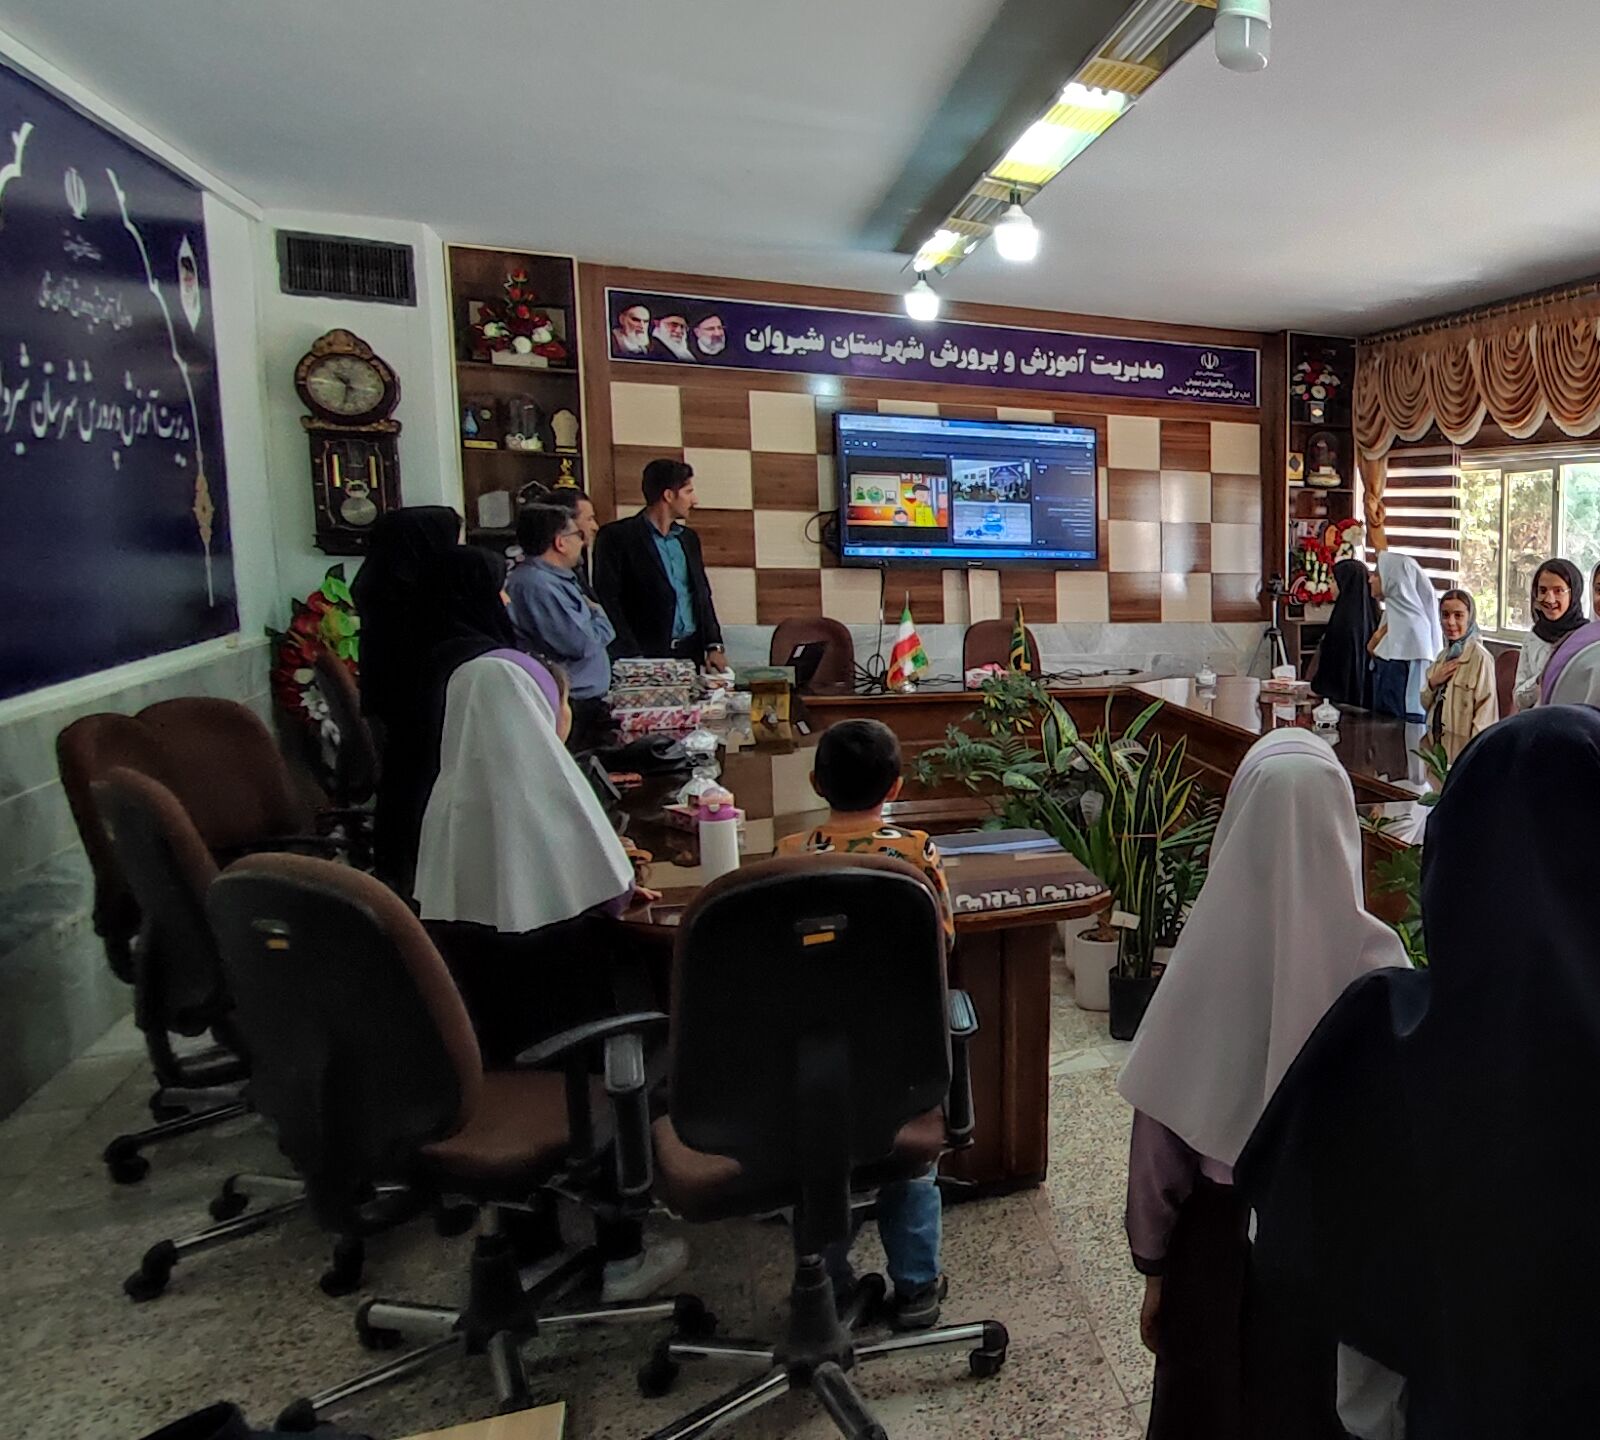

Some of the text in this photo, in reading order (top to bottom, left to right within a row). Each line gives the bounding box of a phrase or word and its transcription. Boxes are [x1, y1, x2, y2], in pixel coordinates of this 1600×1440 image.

[744, 325, 1165, 382] مدیریت آموزش و پرورش شهرستان شیروان
[0, 342, 30, 456] شیرو
[30, 359, 78, 439] شهرستان
[78, 359, 121, 471] پرورش
[121, 369, 159, 447] آموزش
[156, 404, 190, 468] مدیریت
